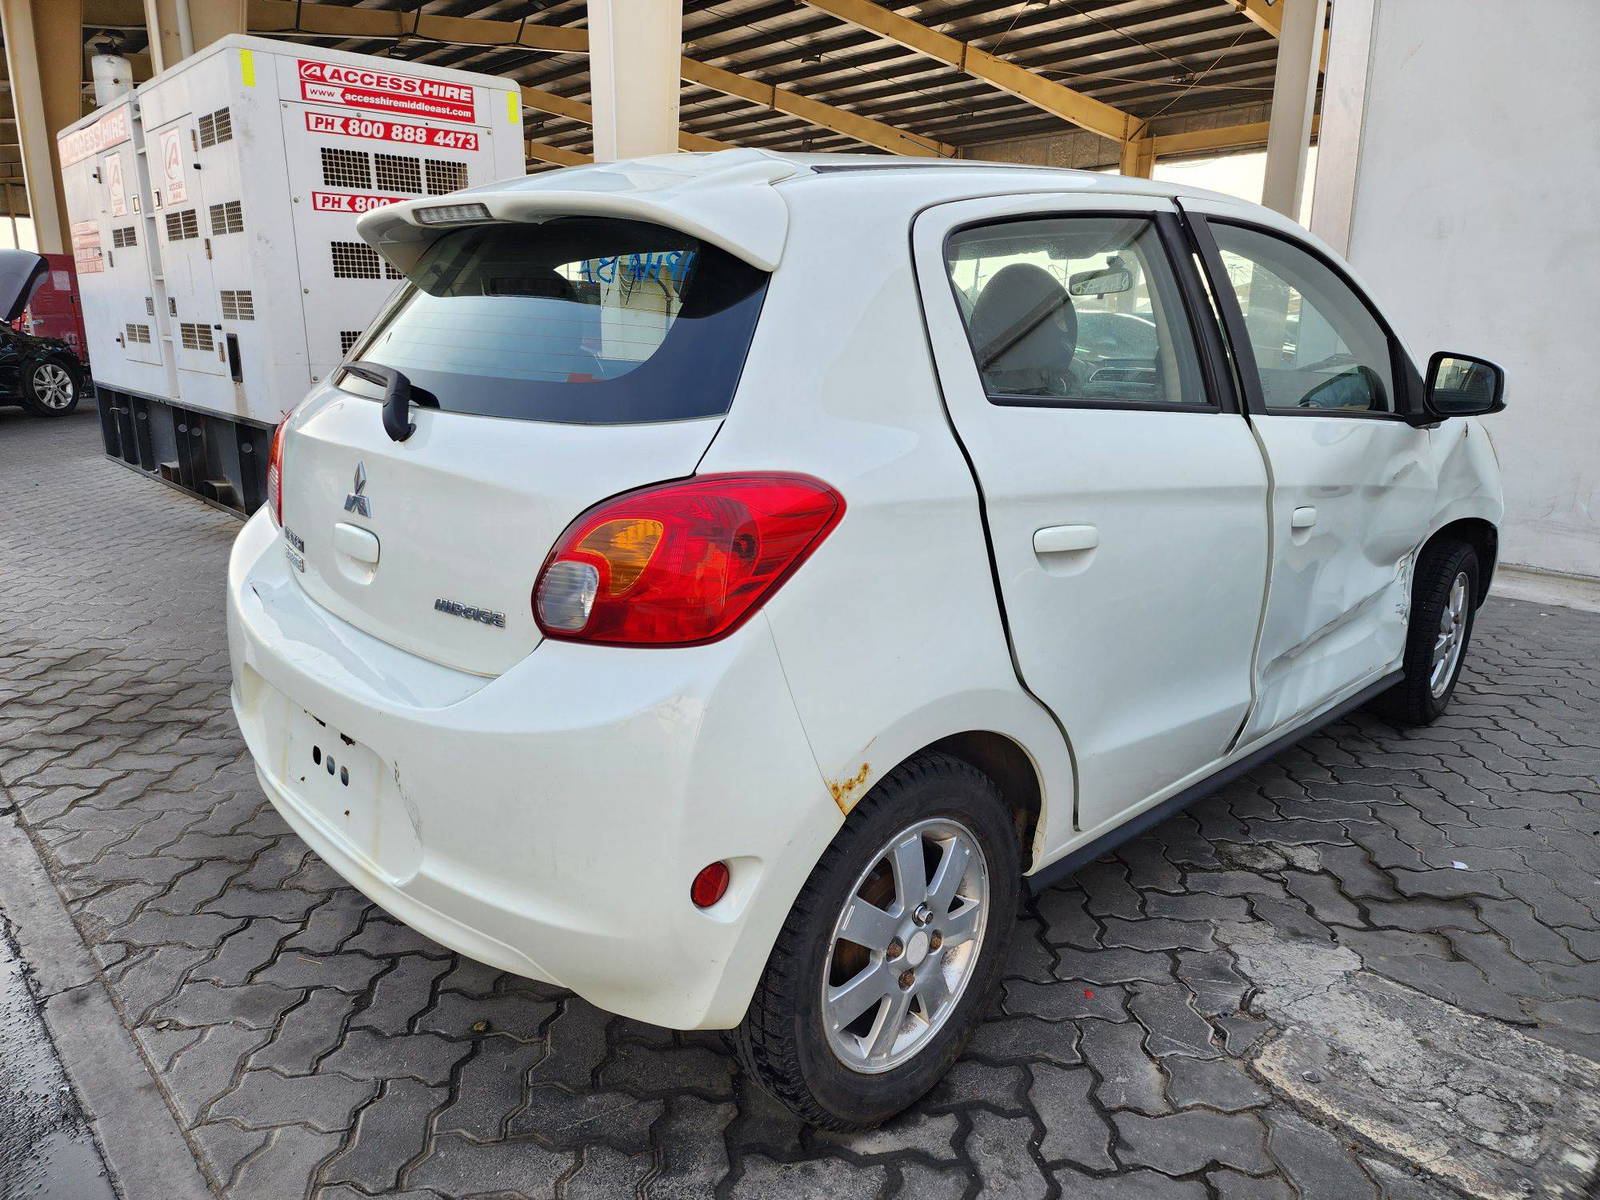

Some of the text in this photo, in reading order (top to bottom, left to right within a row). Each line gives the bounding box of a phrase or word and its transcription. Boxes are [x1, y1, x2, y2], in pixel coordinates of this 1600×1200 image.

[328, 67, 418, 94] ACCESS
[423, 82, 473, 102] HIRE
[309, 88, 472, 119] www accesshiremiddleeast.com
[314, 116, 477, 151] PH 800 888 4473
[321, 195, 342, 209] PH
[434, 597, 506, 629] MIRAGE
